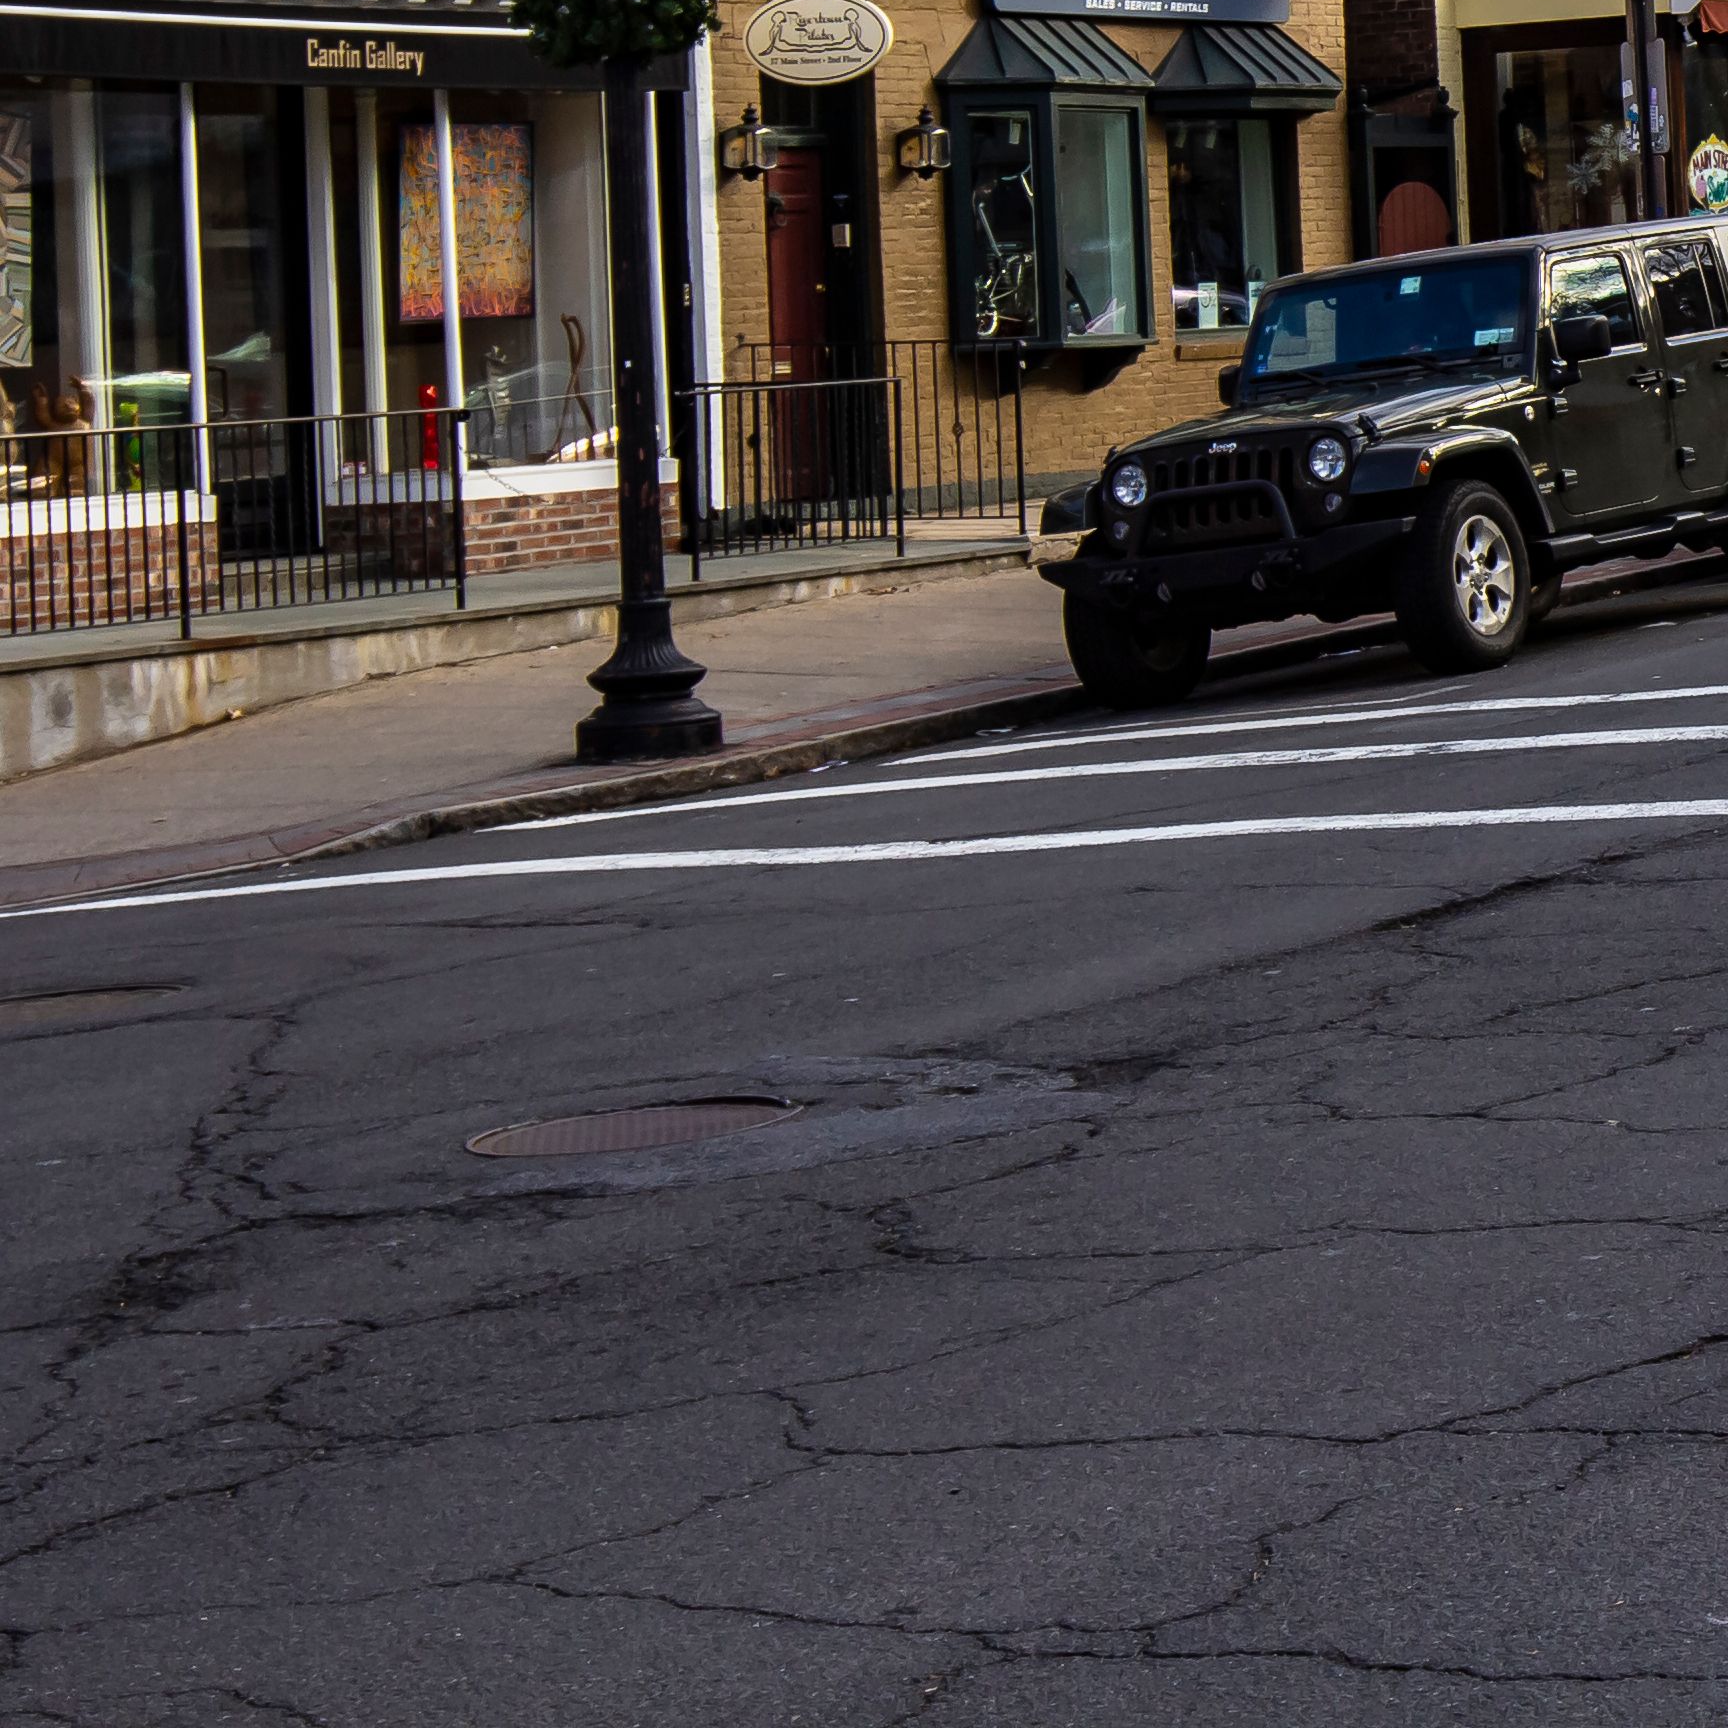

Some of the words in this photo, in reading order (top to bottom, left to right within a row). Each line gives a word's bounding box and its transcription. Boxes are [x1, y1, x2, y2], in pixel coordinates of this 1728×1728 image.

[1124, 0, 1162, 12] SERVICE
[1169, 3, 1209, 14] RENTALS
[306, 38, 361, 68] Canfin
[365, 40, 424, 76] Gallery
[780, 56, 799, 65] Main
[1208, 442, 1237, 454] Jeep
